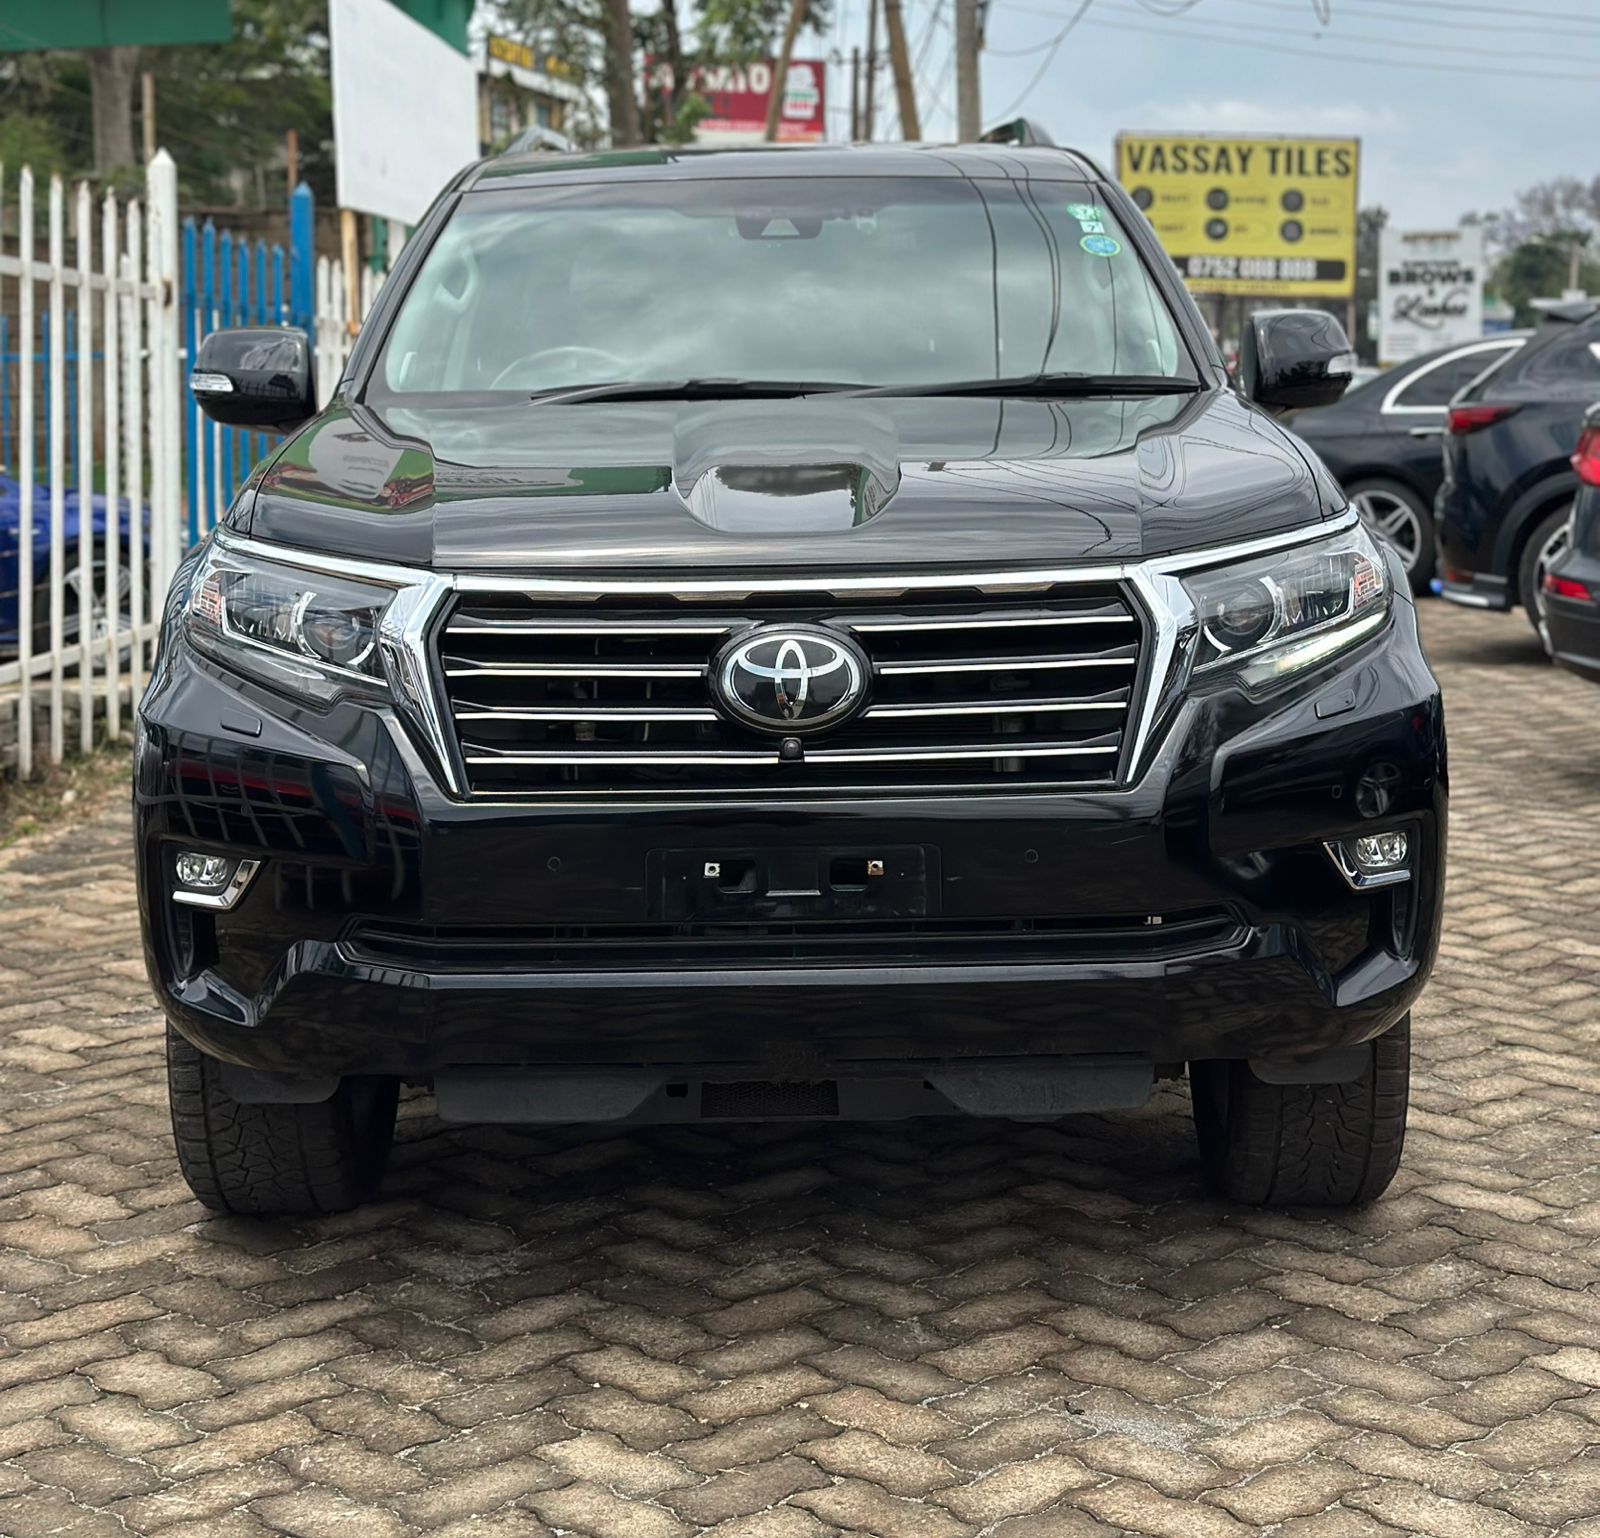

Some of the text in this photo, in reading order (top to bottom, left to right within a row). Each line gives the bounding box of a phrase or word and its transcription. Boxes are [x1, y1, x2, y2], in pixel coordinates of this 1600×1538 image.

[1127, 144, 1352, 177] VASSAY TILES
[1388, 268, 1474, 284] BROWS
